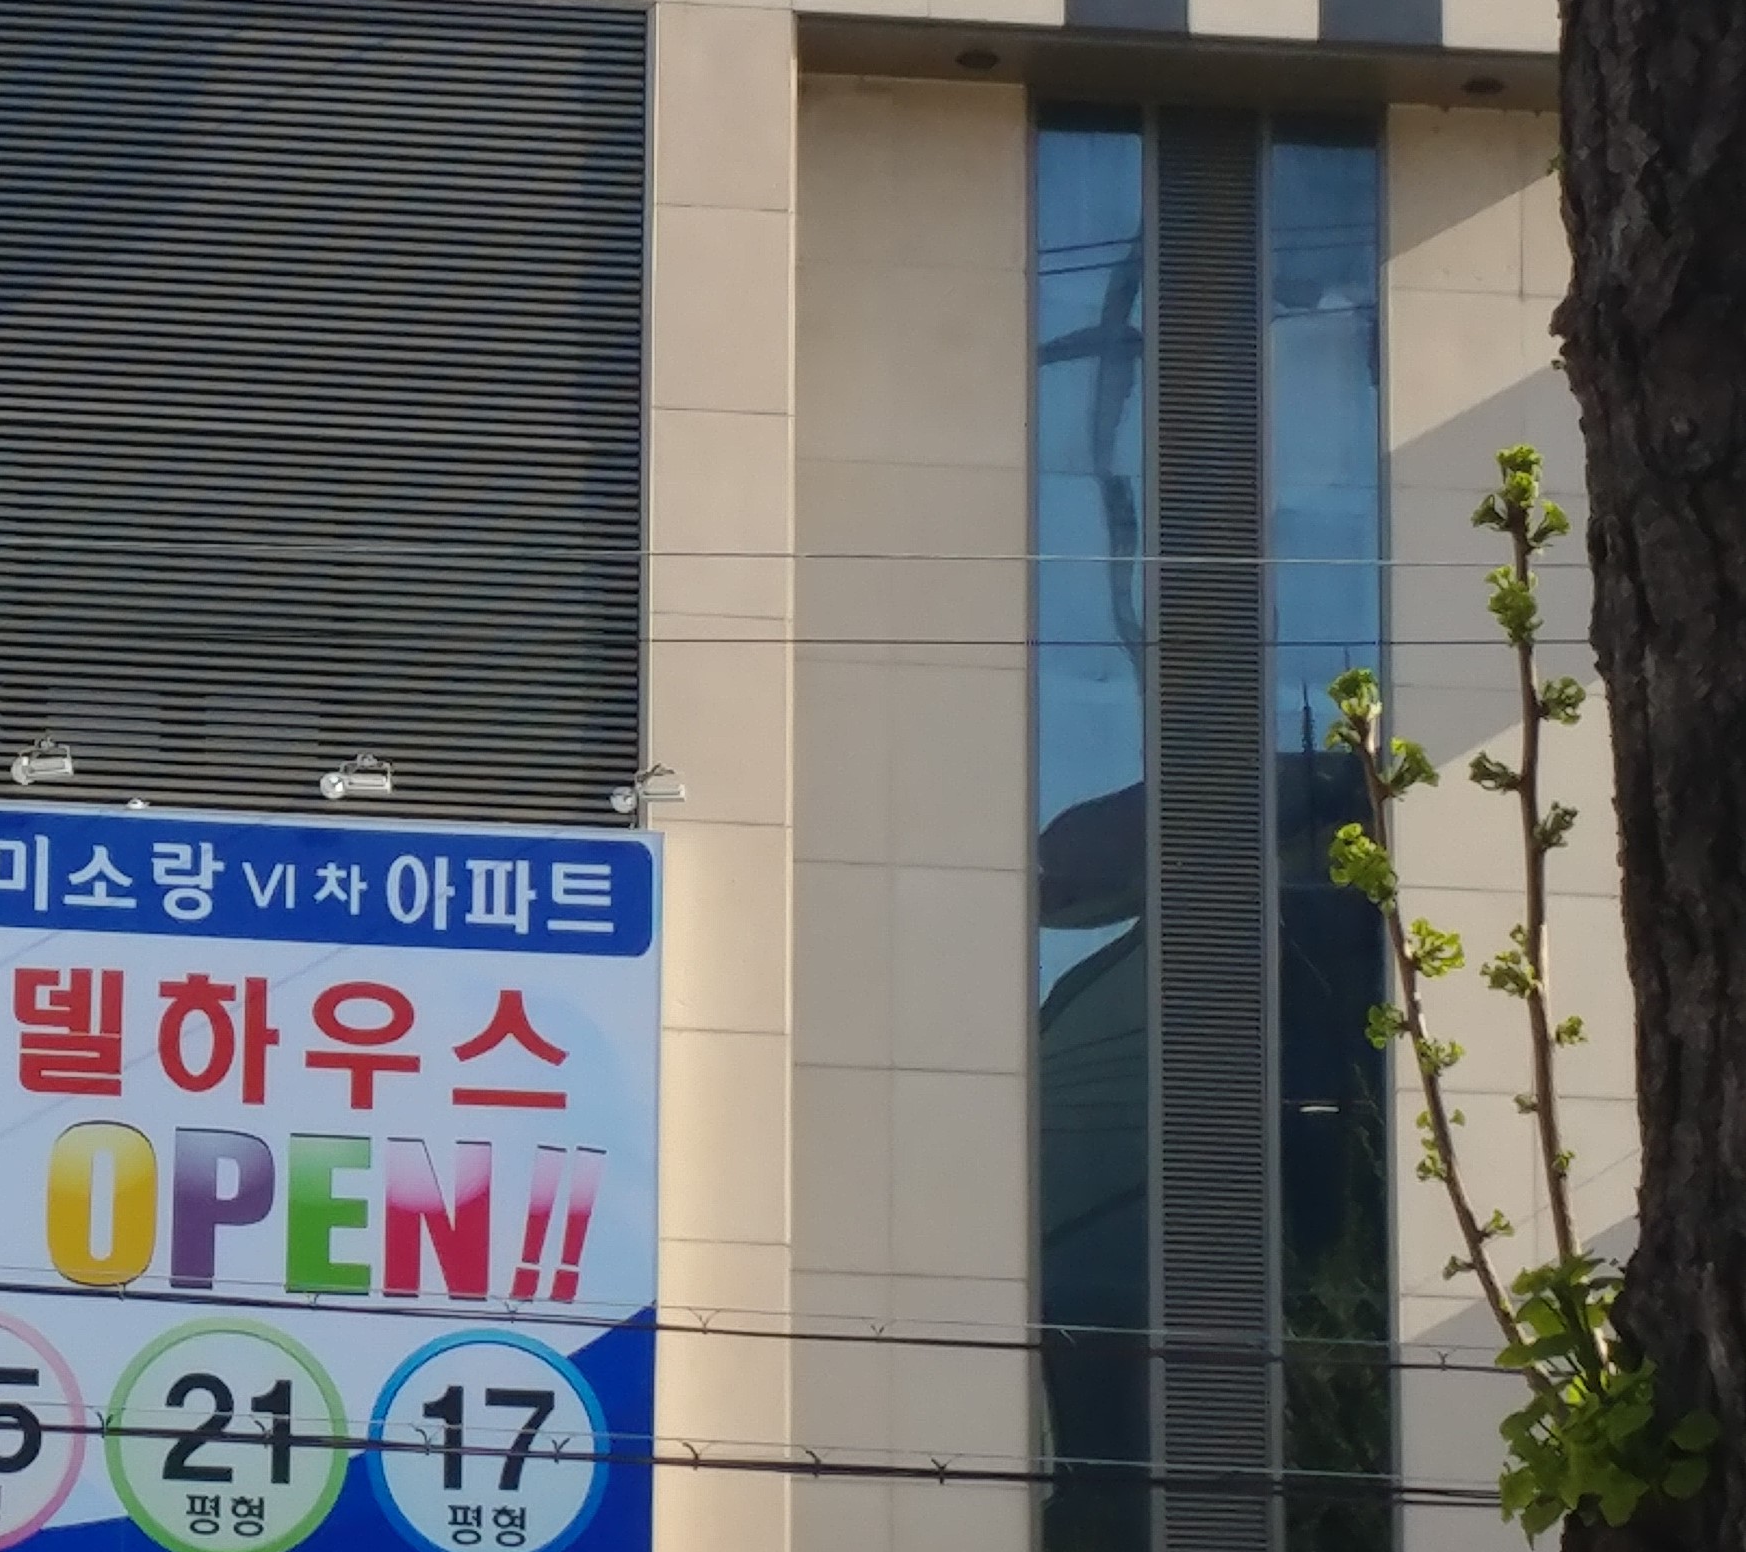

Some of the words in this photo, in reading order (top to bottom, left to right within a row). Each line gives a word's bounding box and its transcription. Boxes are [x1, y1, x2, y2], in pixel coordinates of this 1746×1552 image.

[386, 854, 616, 935] 아파트
[46, 1119, 607, 1303] OPEN!!
[162, 1374, 295, 1485] 21
[422, 1386, 557, 1491] 17
[184, 1493, 267, 1537] 평형
[446, 1503, 529, 1546] 평형
